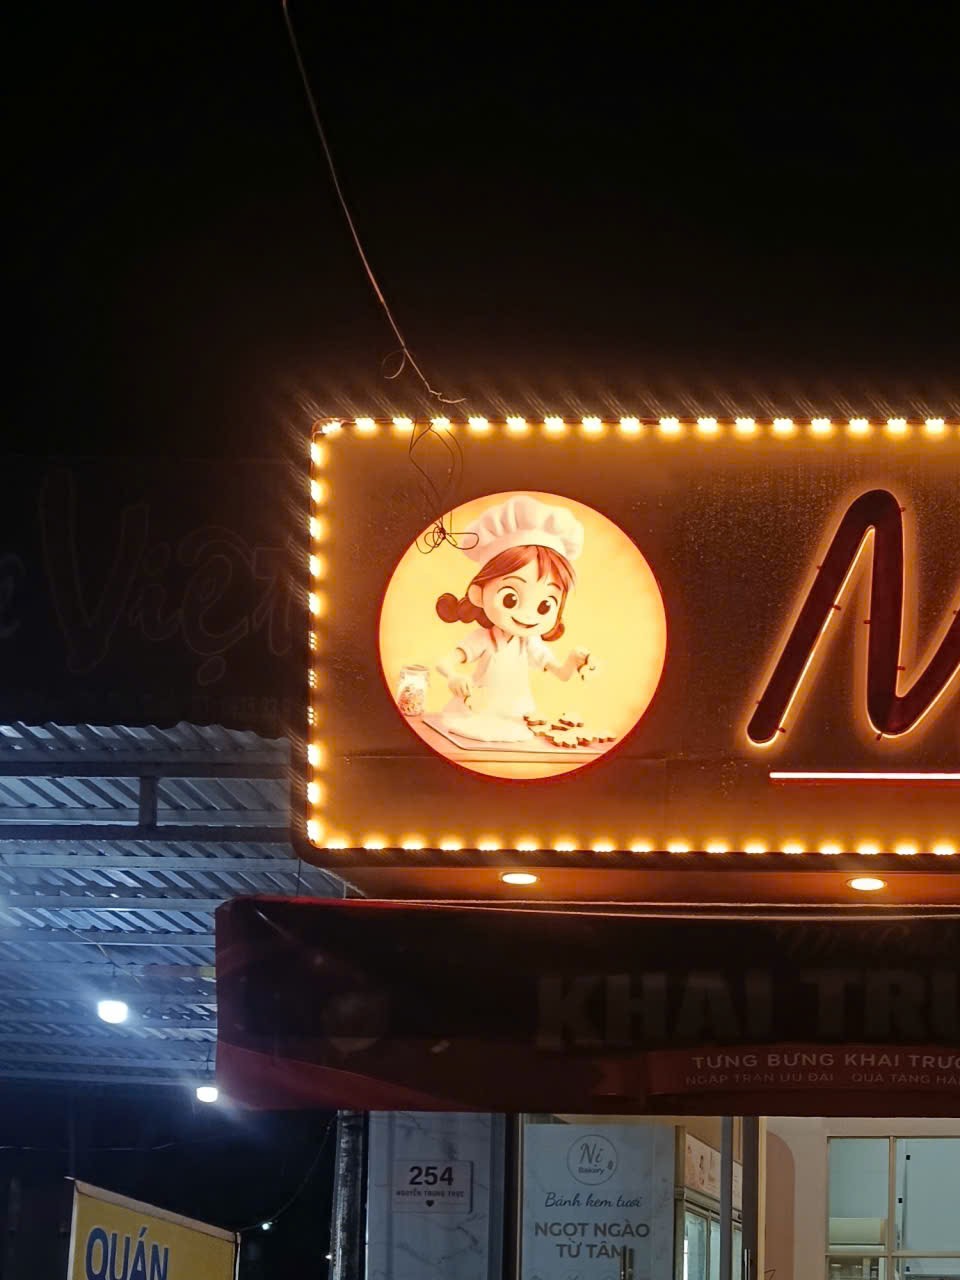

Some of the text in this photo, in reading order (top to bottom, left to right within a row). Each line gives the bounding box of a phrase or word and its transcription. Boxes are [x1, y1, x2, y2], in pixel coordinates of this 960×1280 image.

[535, 971, 773, 1050] KHAI
[844, 1053, 900, 1067] KHAI
[408, 1166, 454, 1186] 254
[594, 1217, 650, 1238] NGÀO
[556, 1236, 583, 1259] TỪ
